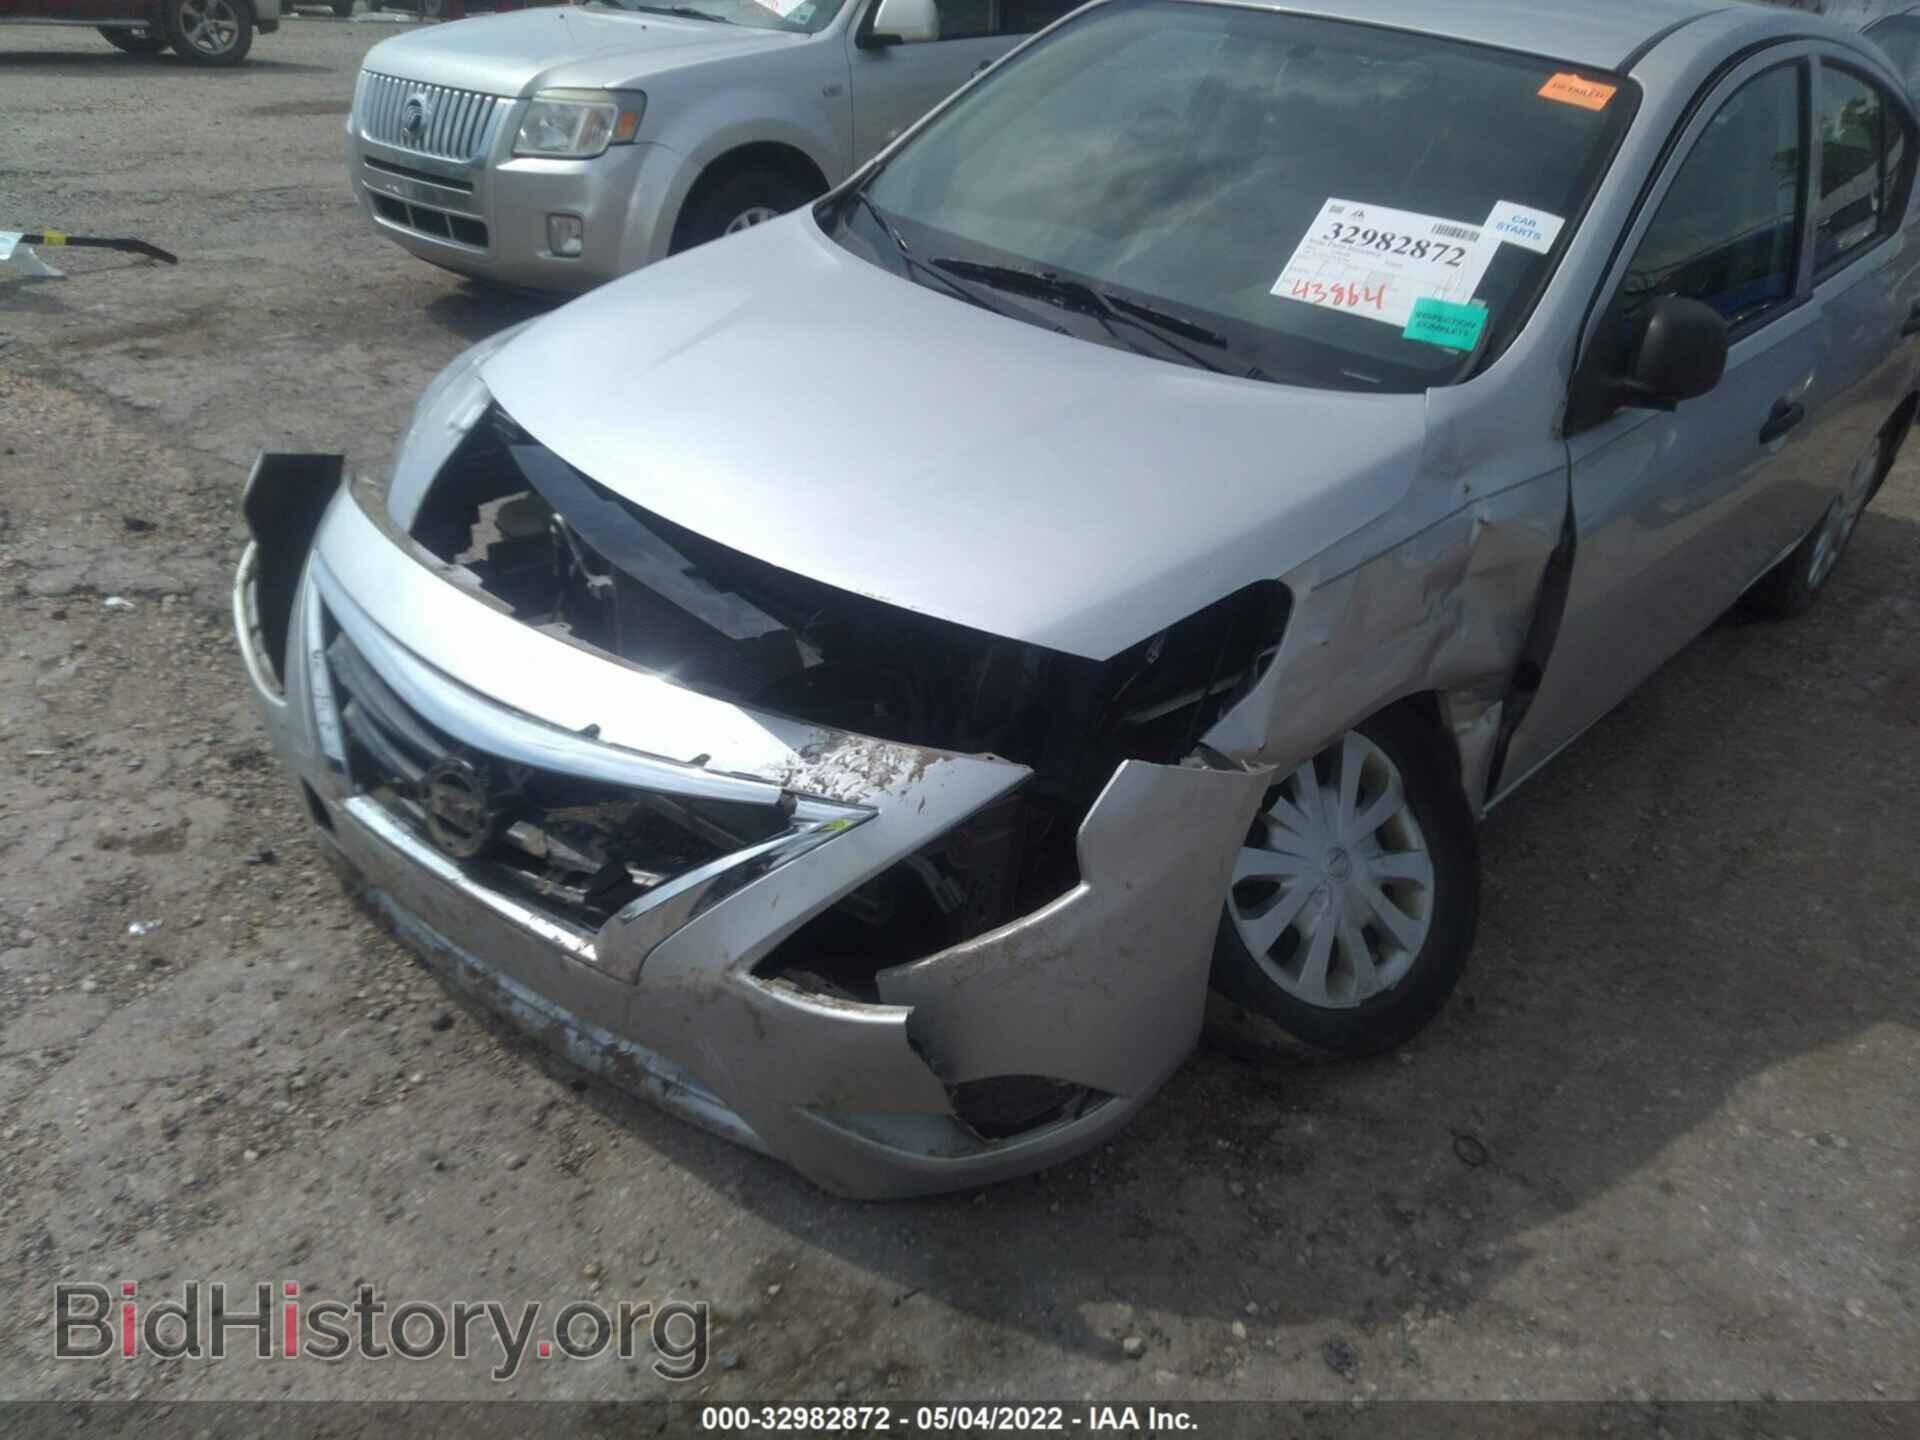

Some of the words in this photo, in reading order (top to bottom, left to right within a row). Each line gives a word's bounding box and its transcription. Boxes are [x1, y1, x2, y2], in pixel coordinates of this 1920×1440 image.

[1511, 214, 1537, 228] CAR
[1496, 222, 1543, 241] STARTS
[1323, 222, 1467, 267] 32982872
